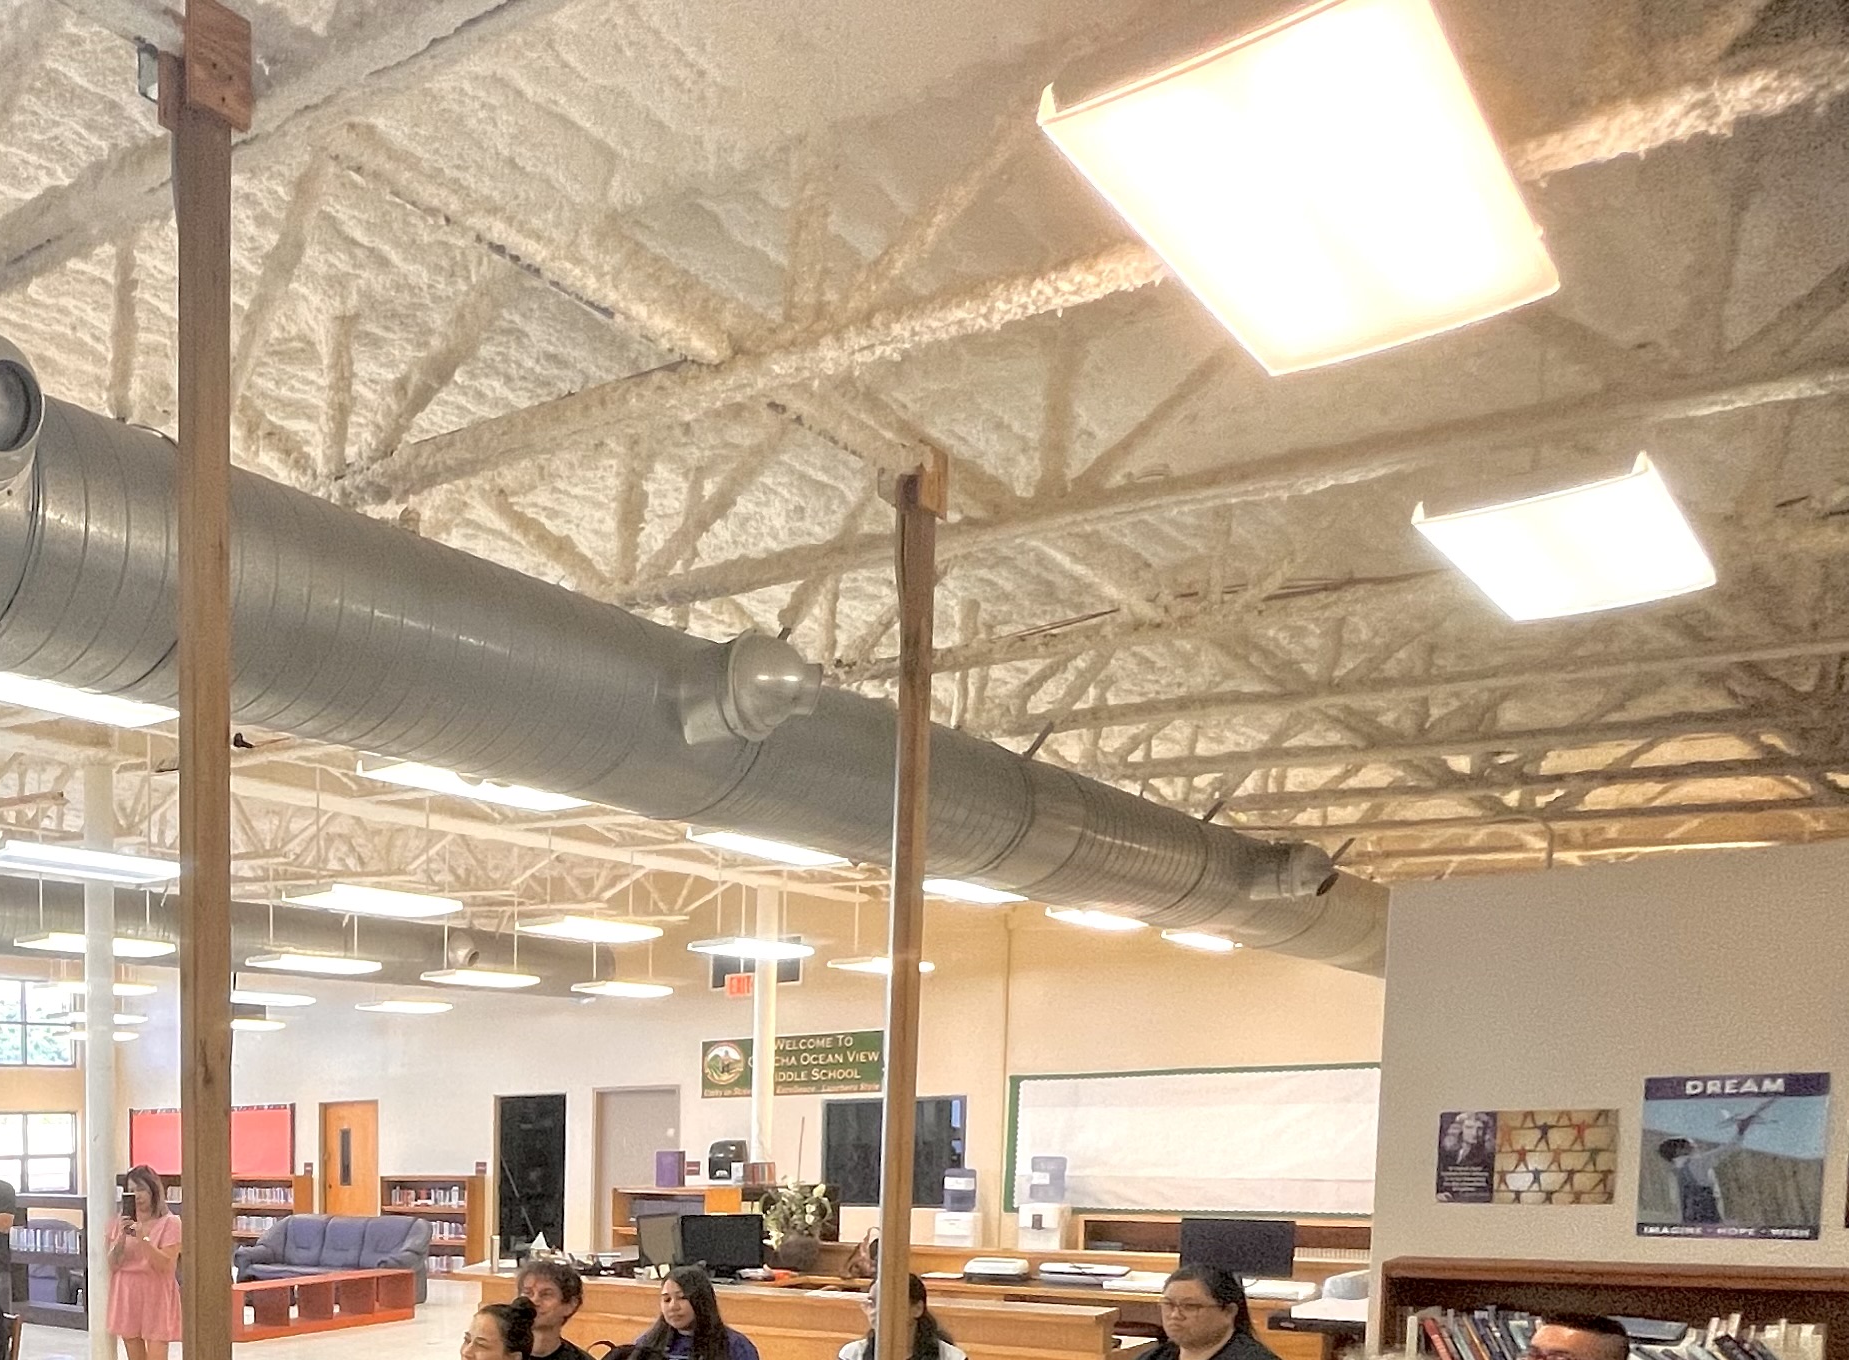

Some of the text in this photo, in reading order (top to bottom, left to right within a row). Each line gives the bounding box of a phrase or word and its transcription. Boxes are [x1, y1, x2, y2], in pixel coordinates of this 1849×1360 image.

[775, 1035, 854, 1050] WELCOME TO
[800, 1053, 844, 1065] OCEAN
[846, 1051, 880, 1062] VIEW
[775, 1068, 862, 1082] IDDLE SCHOOL
[1685, 1078, 1785, 1095] DREAM
